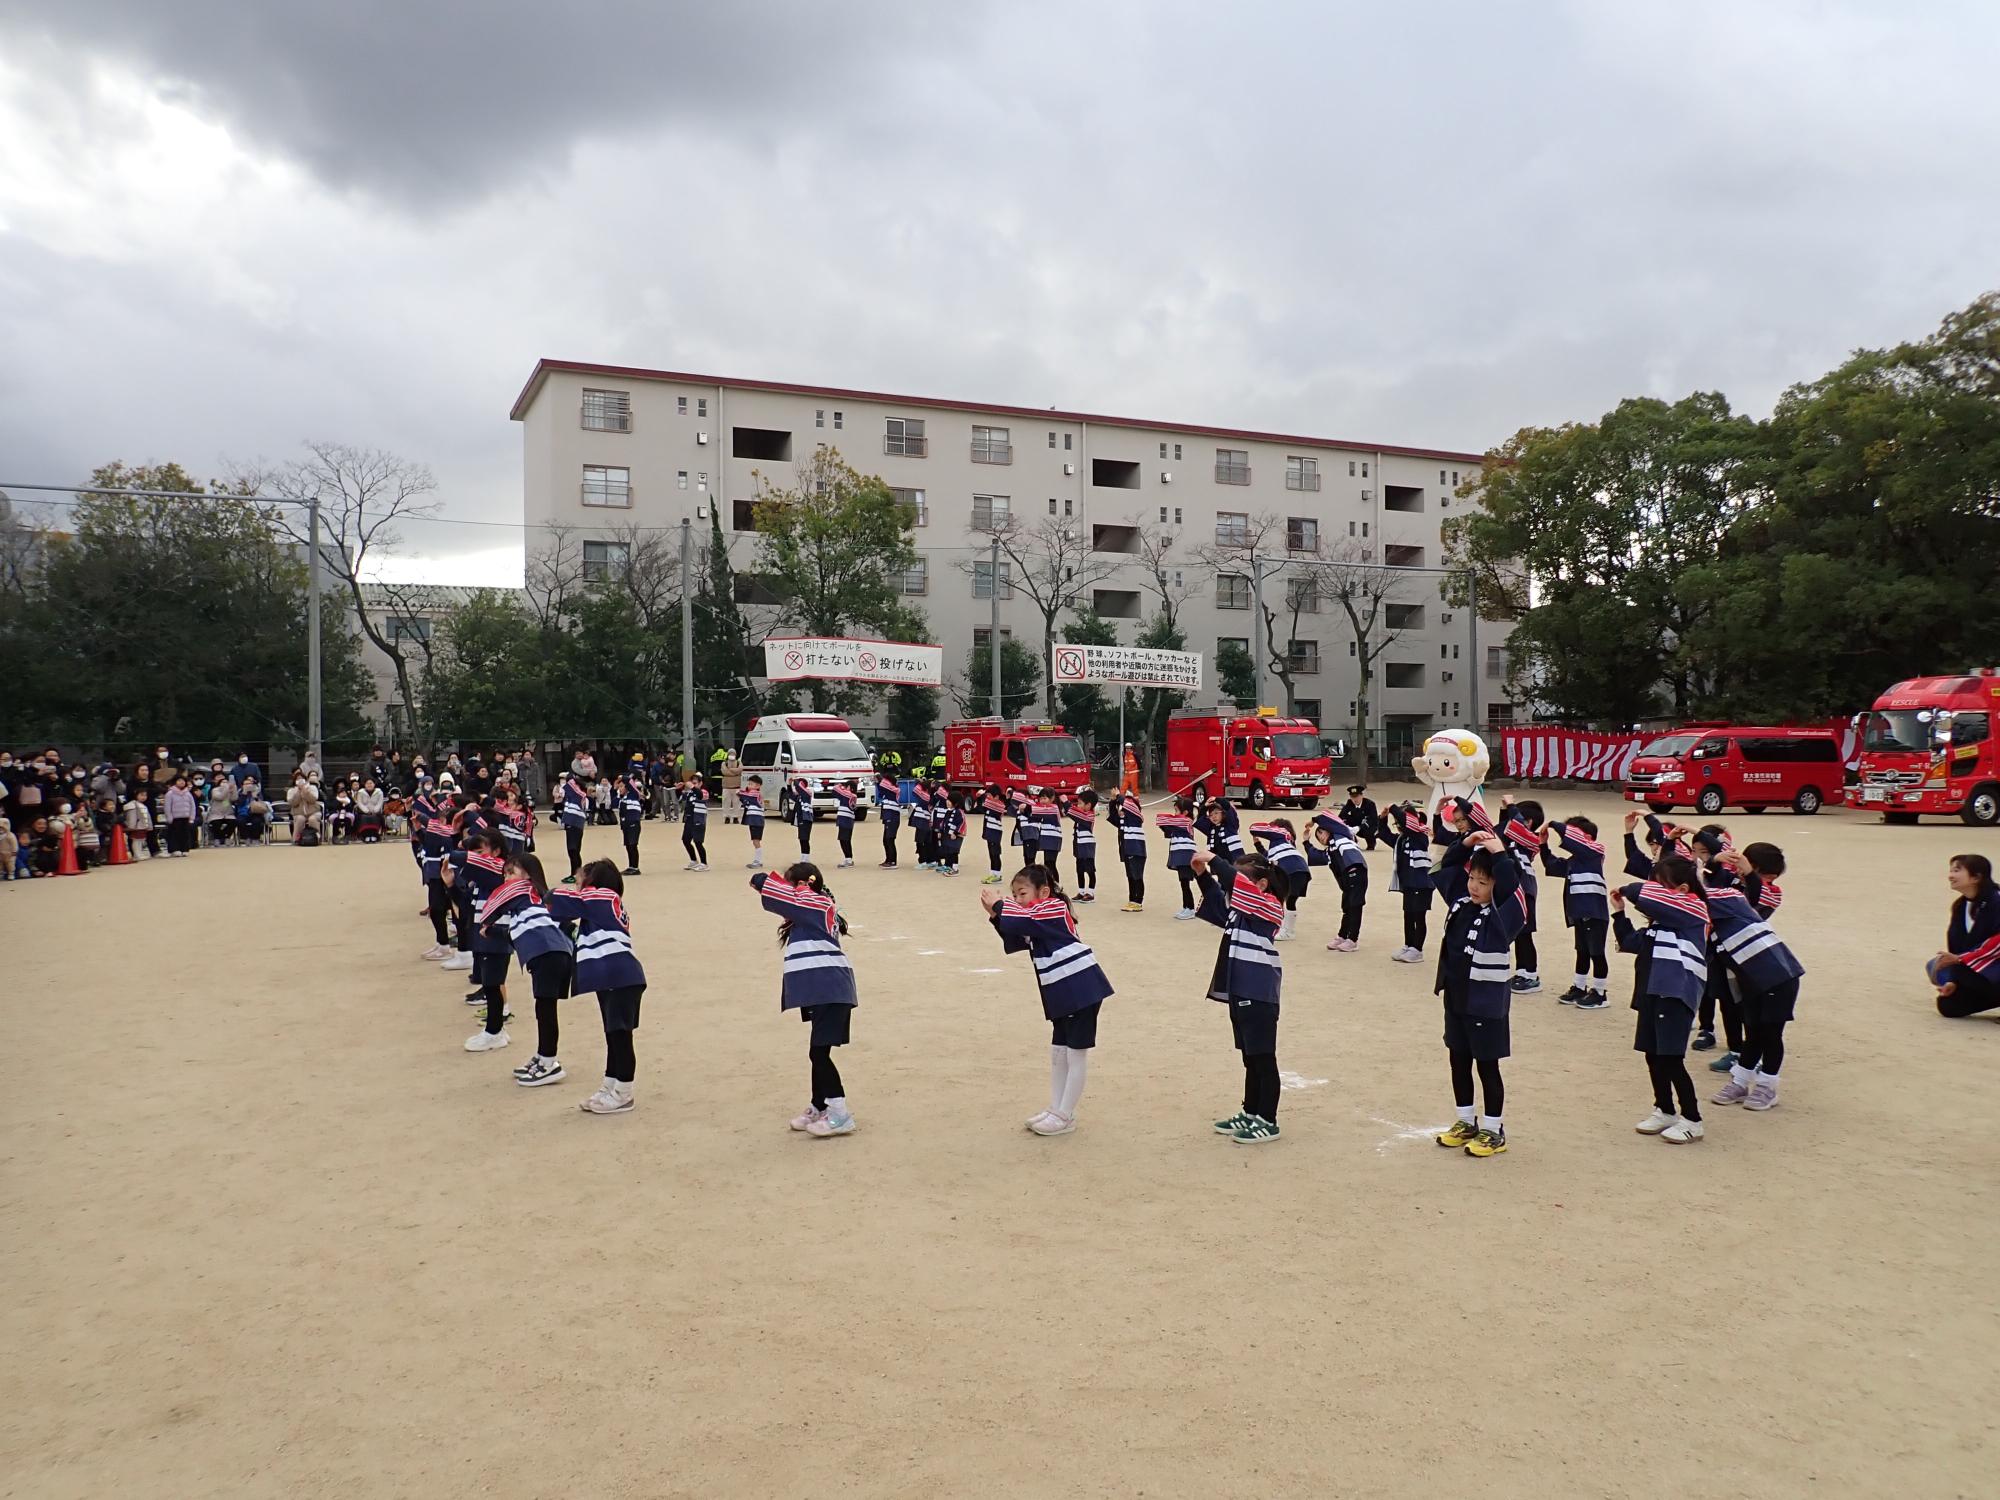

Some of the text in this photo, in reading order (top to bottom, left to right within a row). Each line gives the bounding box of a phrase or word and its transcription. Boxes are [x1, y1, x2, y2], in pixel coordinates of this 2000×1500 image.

[769, 641, 862, 651] ネットに向けてボールを
[805, 653, 928, 671] 打たない 投げない
[1087, 649, 1198, 665] 野球、ソフトボール、サッカーなど
[1087, 660, 1198, 674] 他の利用者や近隣の方に迷惑をかける
[1087, 669, 1200, 684] ようなボール遊びは禁止されています。
